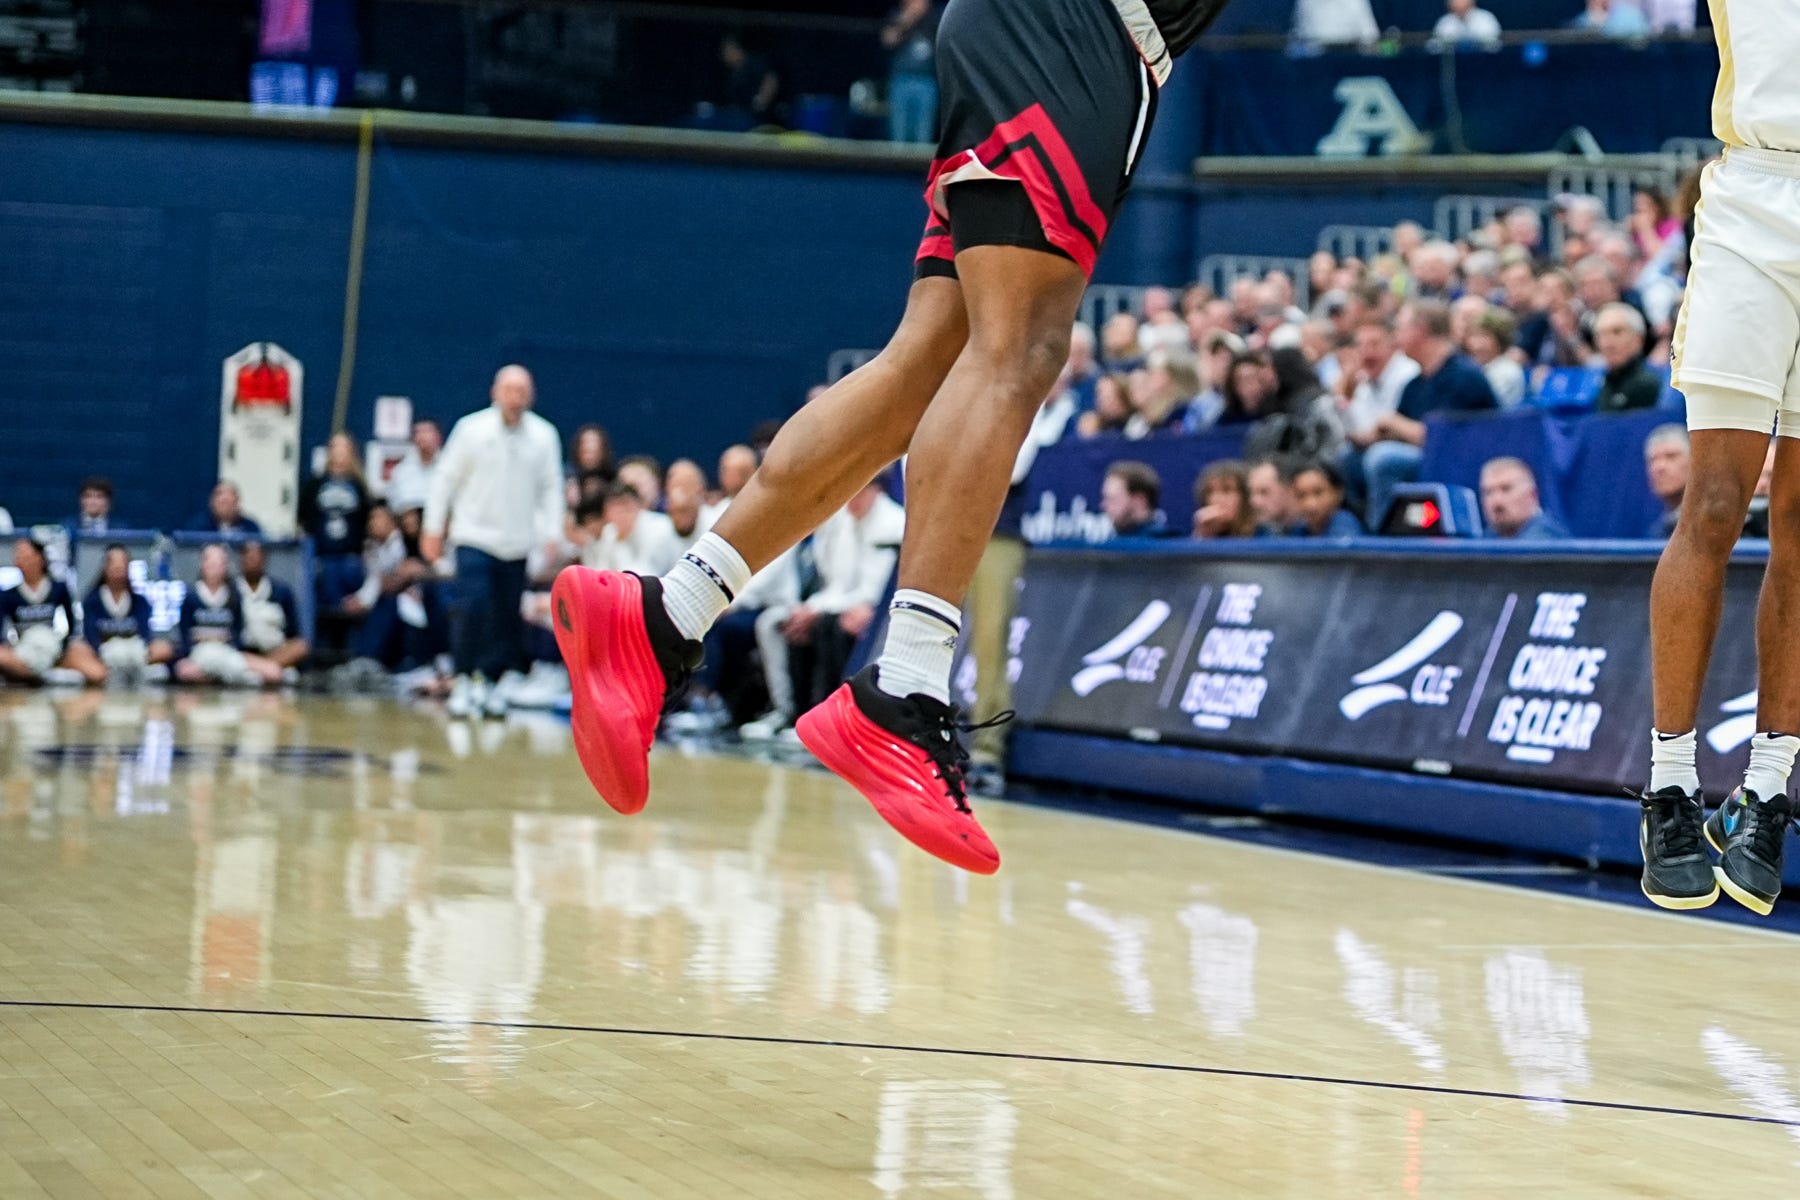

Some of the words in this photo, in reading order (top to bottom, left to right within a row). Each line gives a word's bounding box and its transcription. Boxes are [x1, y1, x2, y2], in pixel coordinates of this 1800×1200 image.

[1529, 592, 1588, 639] THE
[1508, 643, 1607, 694] CHOICE
[1487, 696, 1525, 743] IS
[1514, 698, 1602, 750] CLEAR
